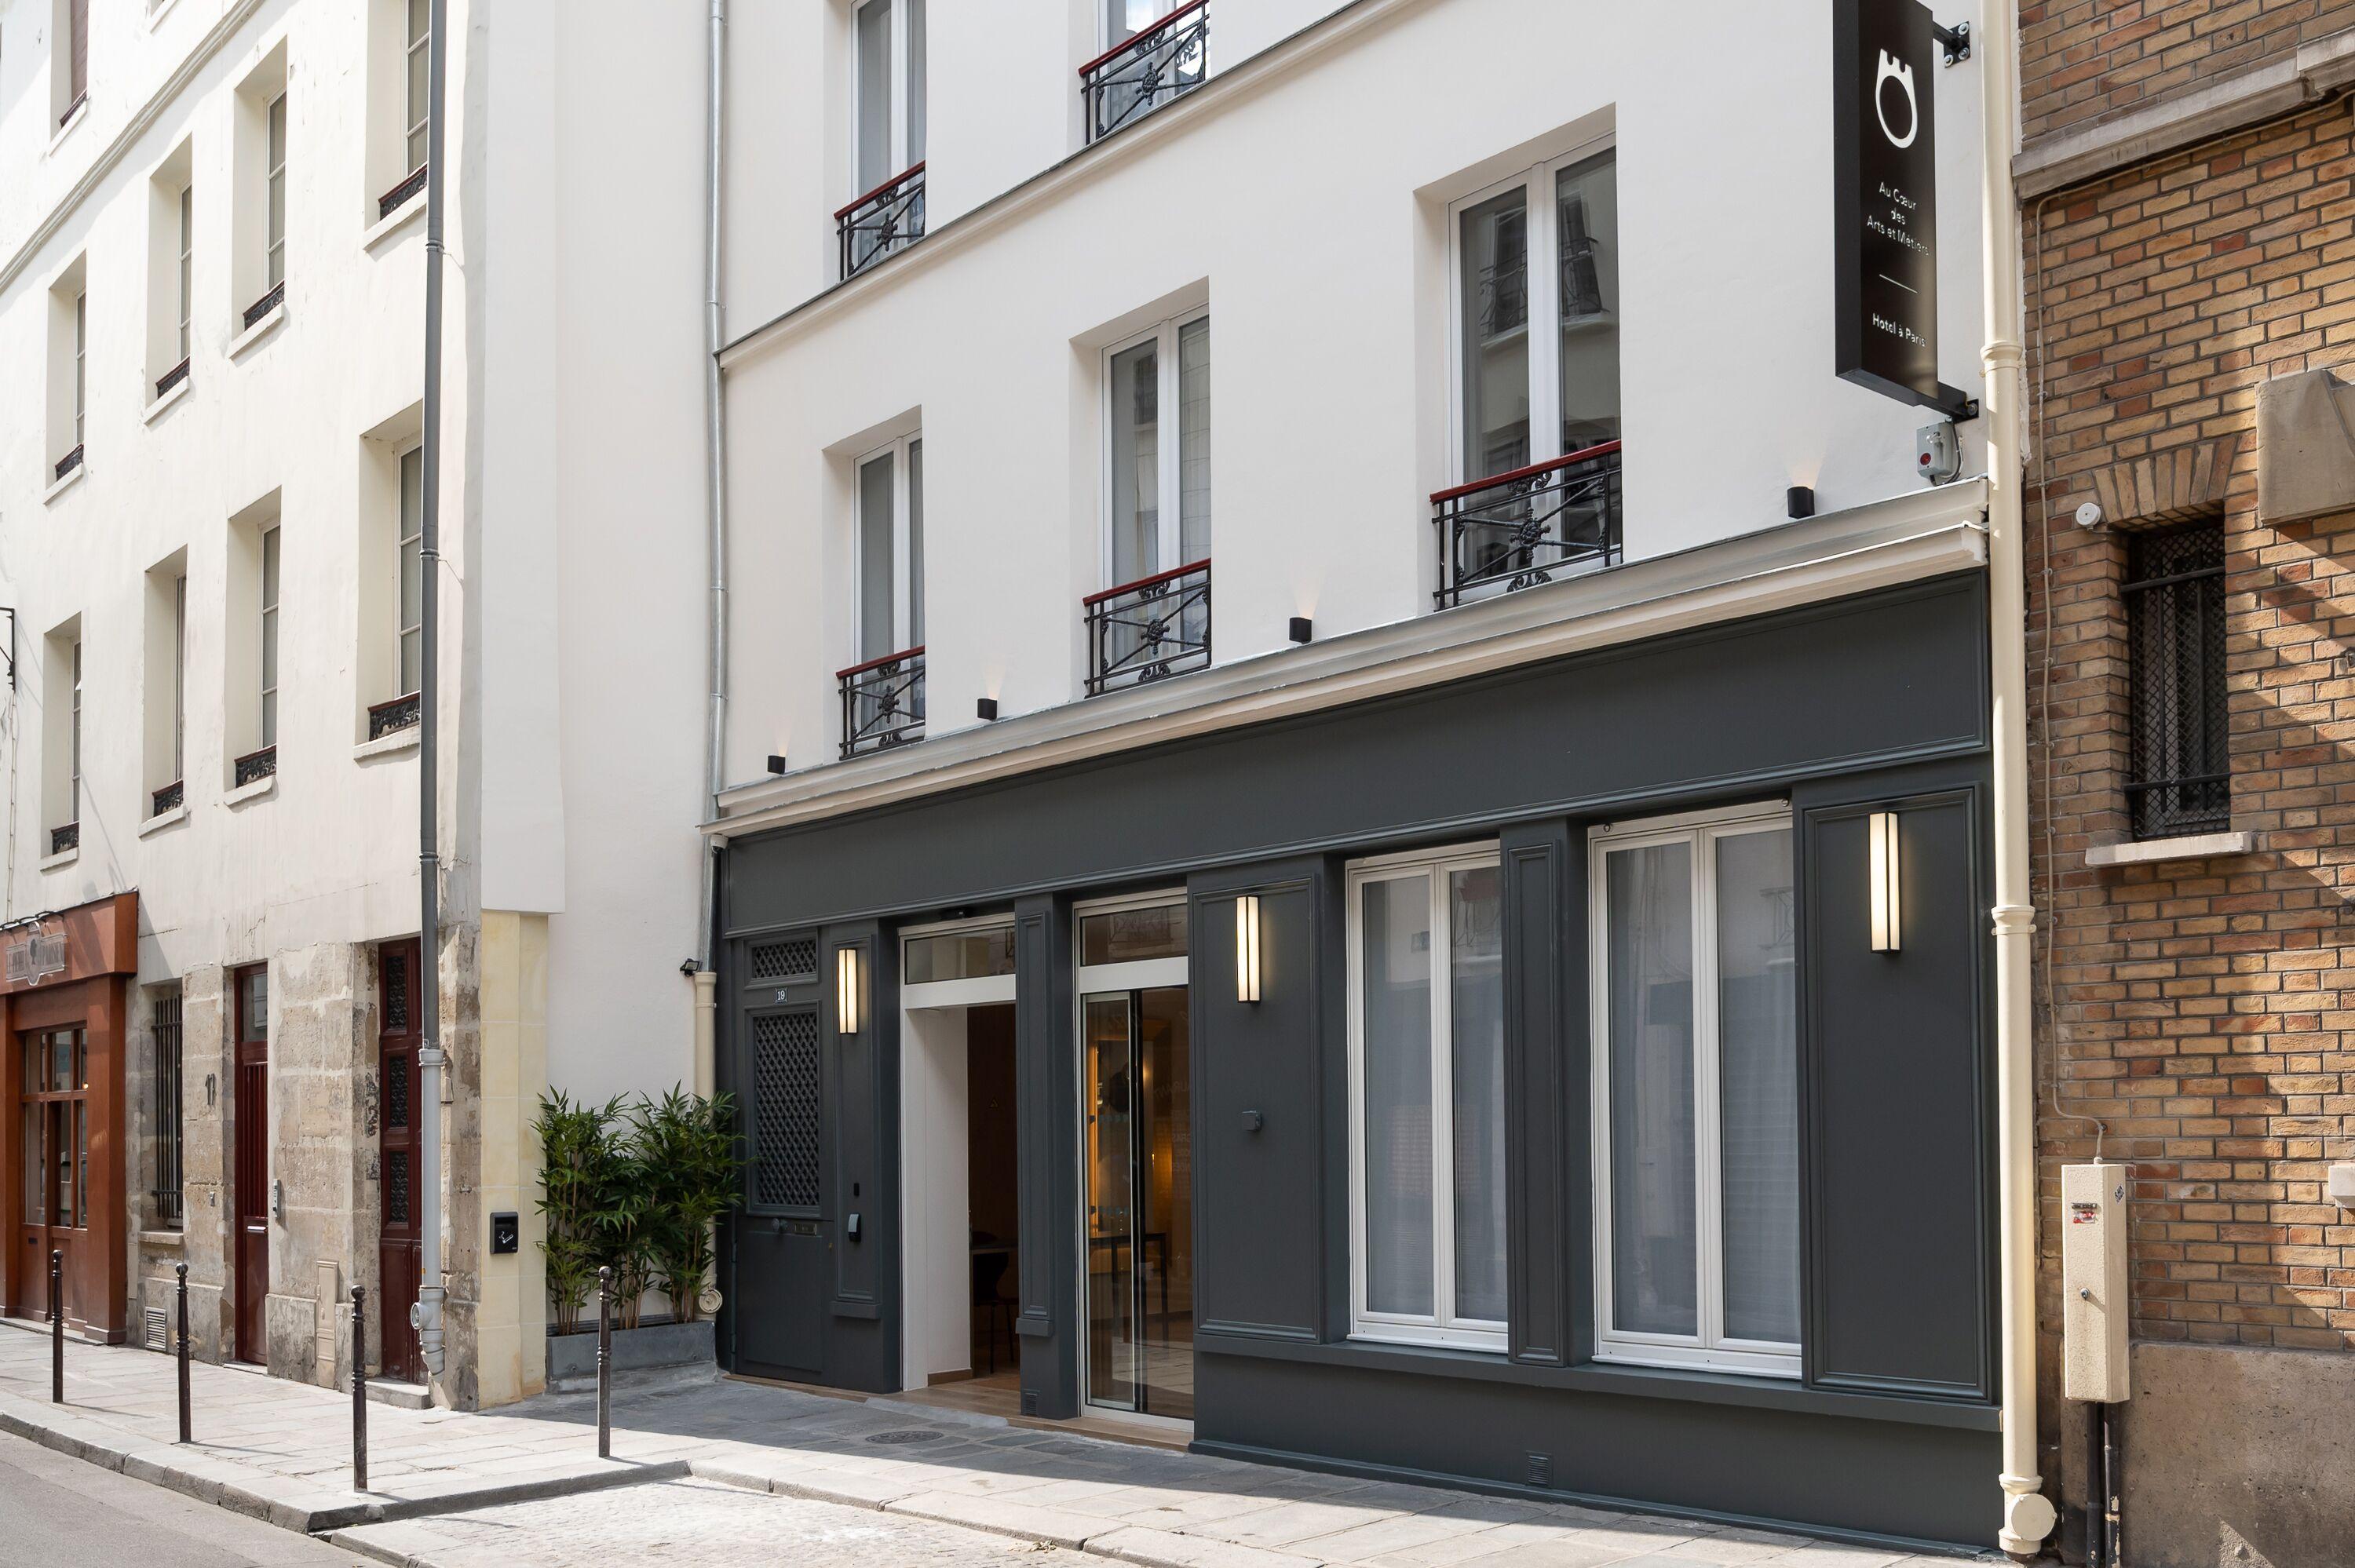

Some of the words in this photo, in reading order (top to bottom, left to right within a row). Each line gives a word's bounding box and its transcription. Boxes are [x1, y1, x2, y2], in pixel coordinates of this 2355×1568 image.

[1879, 181, 1892, 198] Au
[1893, 188, 1917, 210] Cœur
[1890, 207, 1906, 225] des
[1867, 215, 1886, 235] Arts
[1887, 226, 1897, 239] et
[1897, 229, 1930, 256] Métiers
[1872, 312, 1897, 335] Hotel
[1898, 324, 1904, 337] à
[1905, 327, 1926, 348] Paris
[777, 990, 785, 1001] 19
